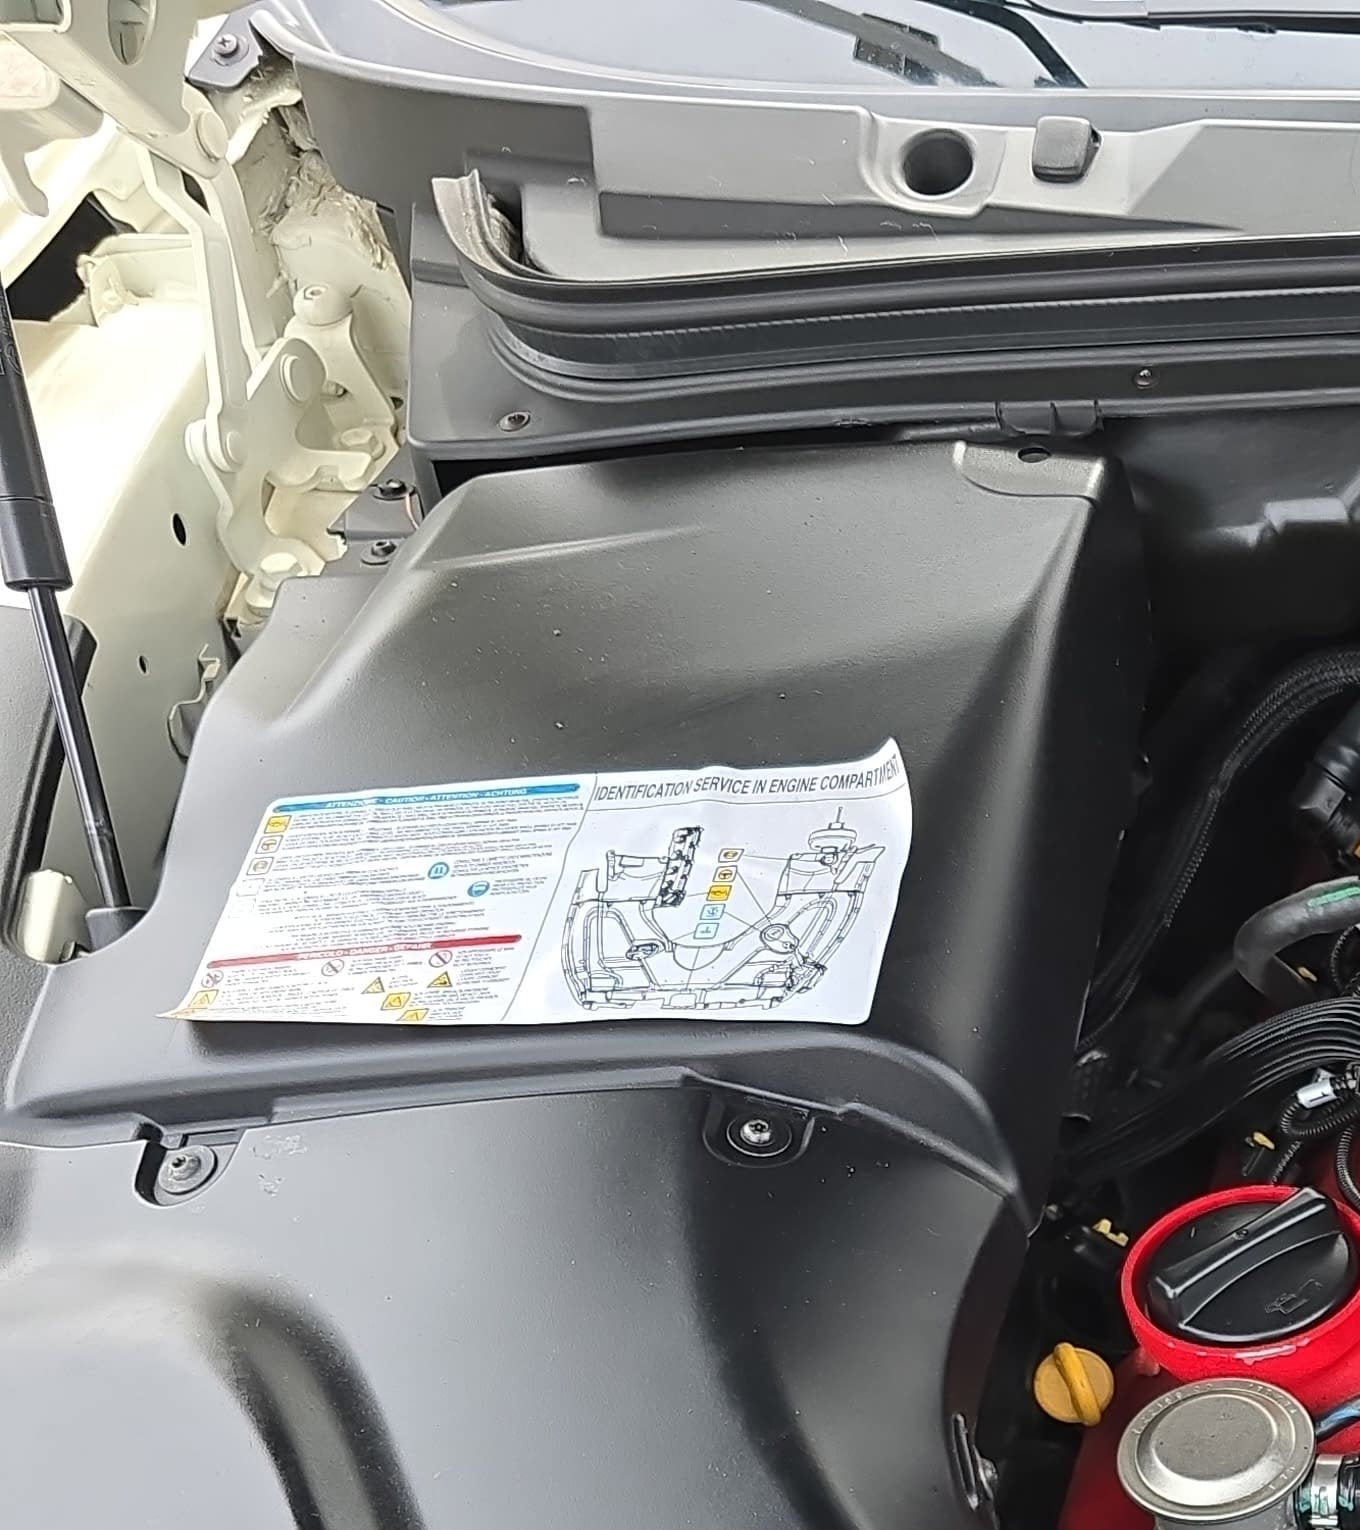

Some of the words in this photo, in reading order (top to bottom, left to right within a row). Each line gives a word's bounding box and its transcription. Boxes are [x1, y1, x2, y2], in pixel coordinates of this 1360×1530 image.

[693, 777, 750, 794] SERVICE
[752, 779, 767, 794] IN
[768, 777, 817, 793] ENGINE
[820, 753, 901, 790] COMPARTMENT
